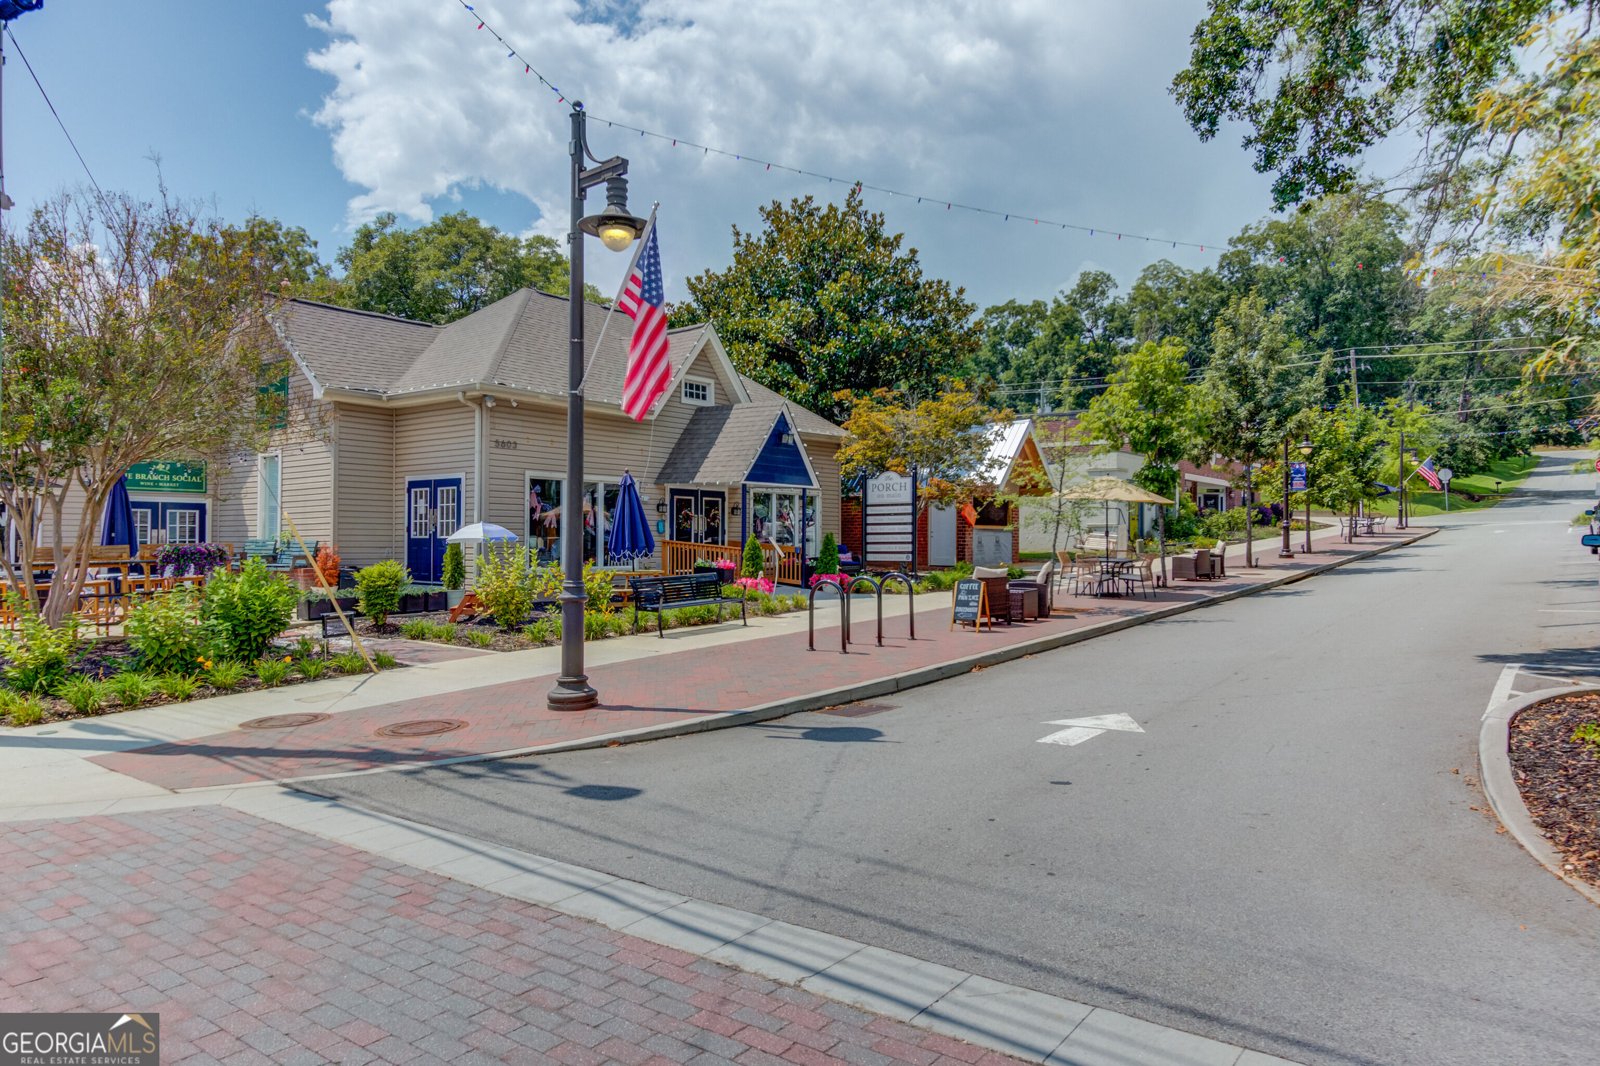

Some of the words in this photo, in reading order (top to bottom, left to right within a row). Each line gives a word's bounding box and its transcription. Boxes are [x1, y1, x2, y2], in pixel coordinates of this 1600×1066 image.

[135, 473, 170, 482] BRANCH
[172, 475, 202, 483] SOCIAL
[871, 482, 907, 492] PORCH
